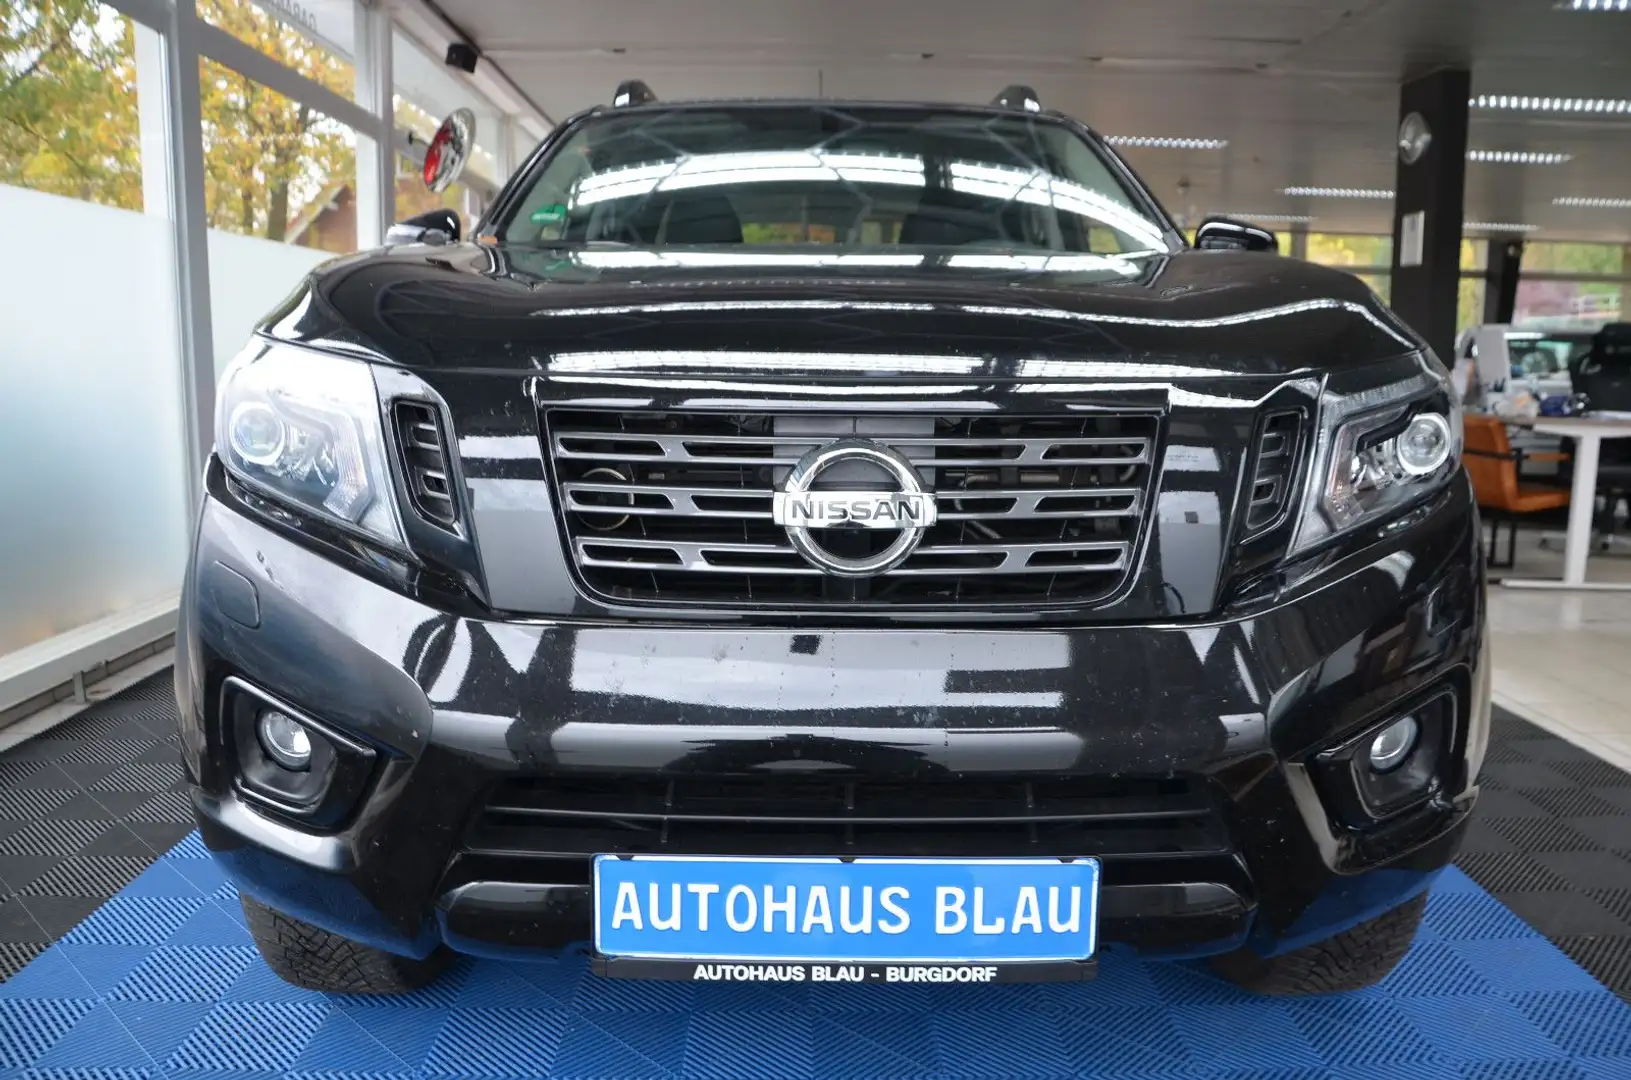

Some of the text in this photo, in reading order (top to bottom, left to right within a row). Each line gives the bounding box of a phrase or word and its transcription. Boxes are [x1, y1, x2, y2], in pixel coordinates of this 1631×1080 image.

[791, 499, 920, 520] NISSAN
[611, 881, 1081, 935] AUTOHAUS BLAU
[693, 964, 806, 981] AUTOHAUS
[811, 966, 865, 982] BLAU
[885, 966, 998, 983] BURGDORF
